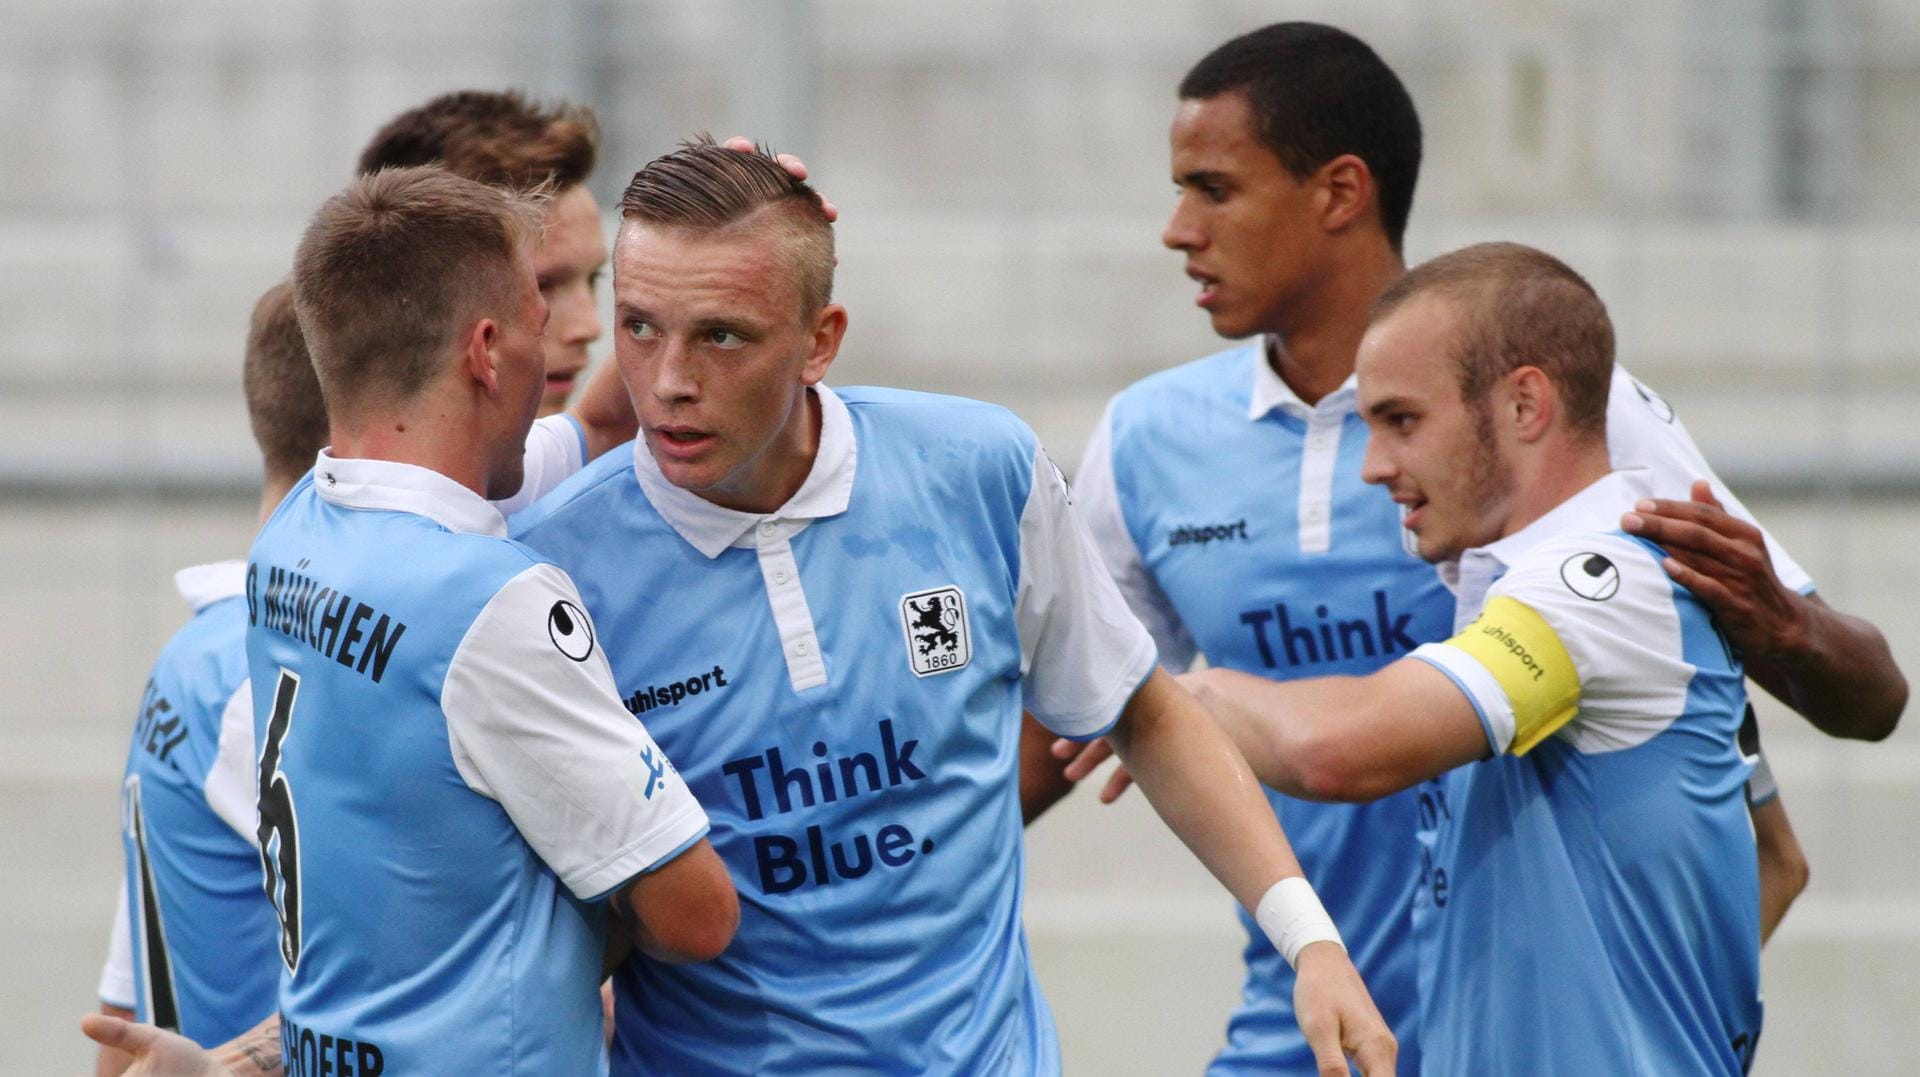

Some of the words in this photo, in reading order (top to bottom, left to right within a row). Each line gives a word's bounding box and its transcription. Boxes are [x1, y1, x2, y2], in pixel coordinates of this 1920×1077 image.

[1168, 518, 1249, 547] uhlsport
[264, 557, 407, 684] MÜNCHEN
[1240, 590, 1419, 669] Think
[1482, 626, 1545, 682] uhlsport
[622, 665, 728, 716] uhlsport
[924, 653, 958, 670] 1860
[722, 719, 927, 821] Think
[256, 665, 301, 978] 6
[754, 824, 934, 895] Blue.
